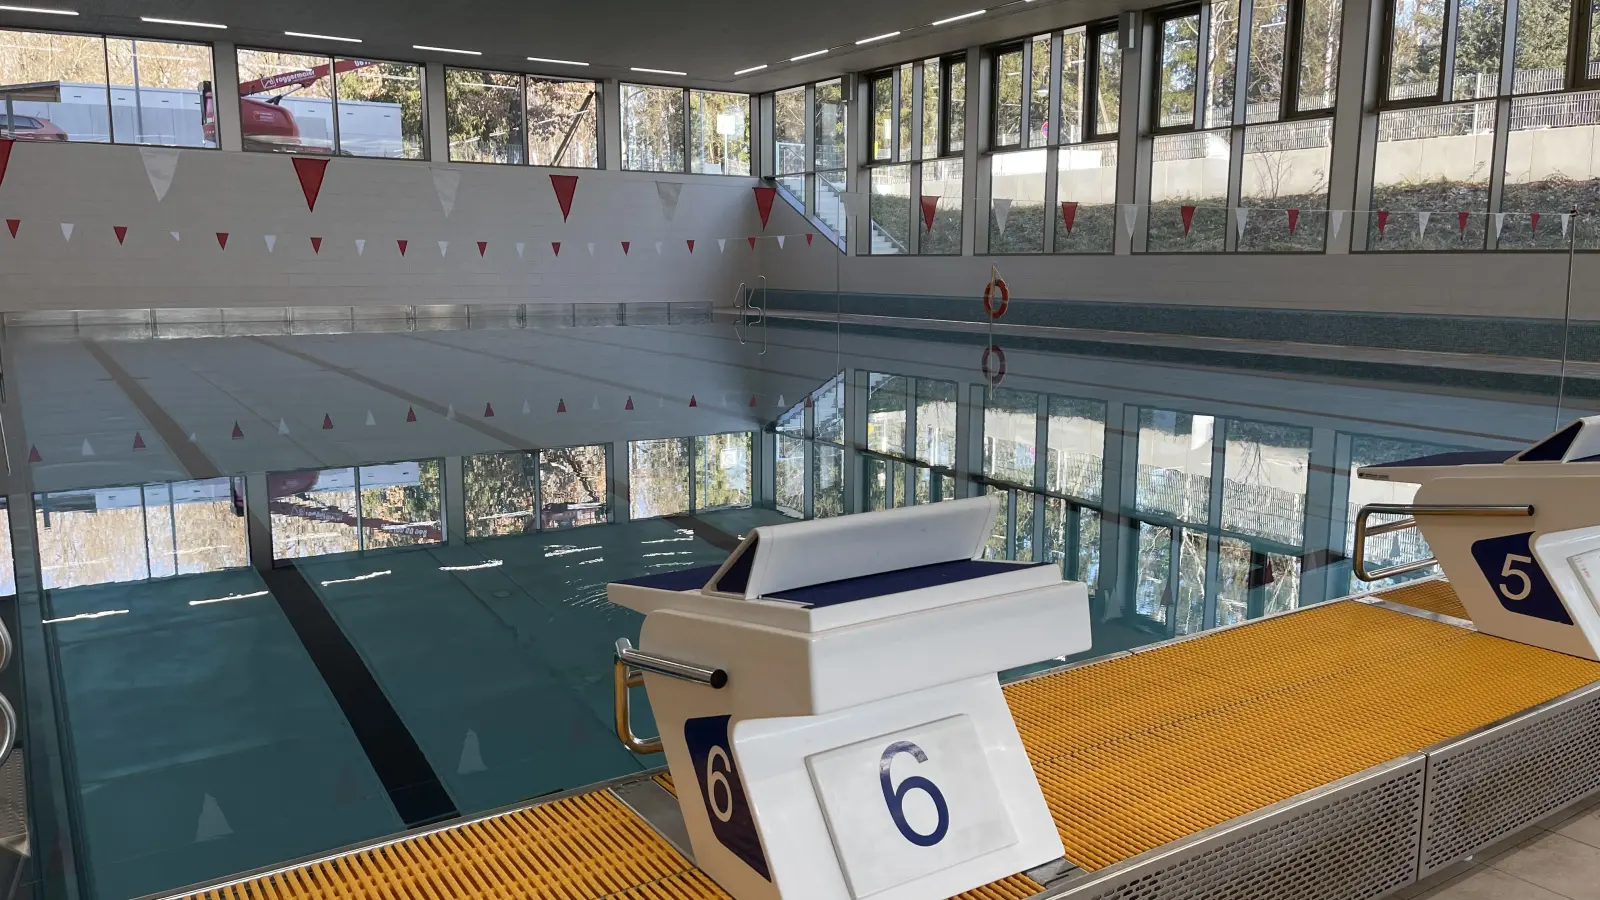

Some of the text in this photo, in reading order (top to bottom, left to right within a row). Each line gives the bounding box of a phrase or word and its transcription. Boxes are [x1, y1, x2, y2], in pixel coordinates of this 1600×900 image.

[1499, 553, 1532, 600] 5
[706, 745, 733, 823] 6
[879, 740, 949, 847] 6
